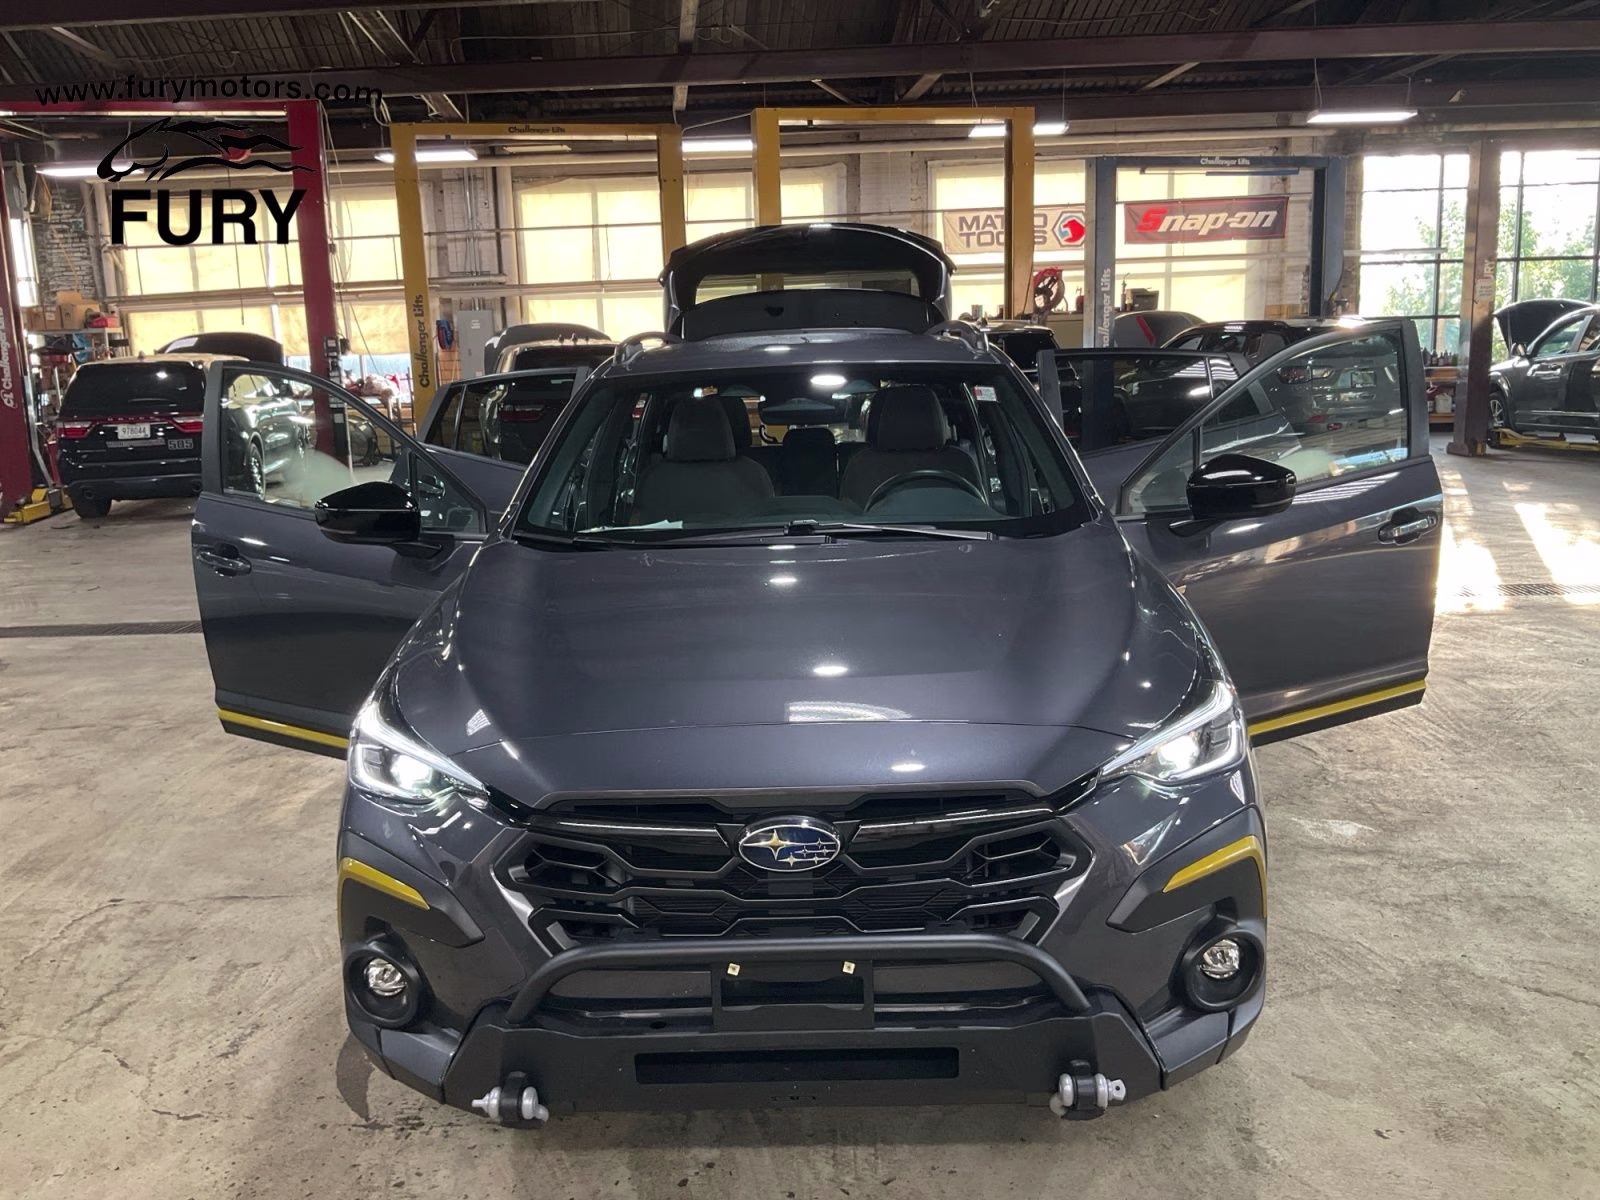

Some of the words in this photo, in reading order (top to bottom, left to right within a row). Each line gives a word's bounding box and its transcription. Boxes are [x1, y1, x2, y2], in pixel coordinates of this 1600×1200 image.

[958, 213, 1048, 232] MATO
[1136, 208, 1278, 235] Snap-on
[958, 230, 1048, 248] TOS
[1101, 268, 1111, 291] Lifts
[413, 294, 424, 317] Lifts
[1098, 293, 1113, 347] allenger
[414, 320, 430, 388] Challenger
